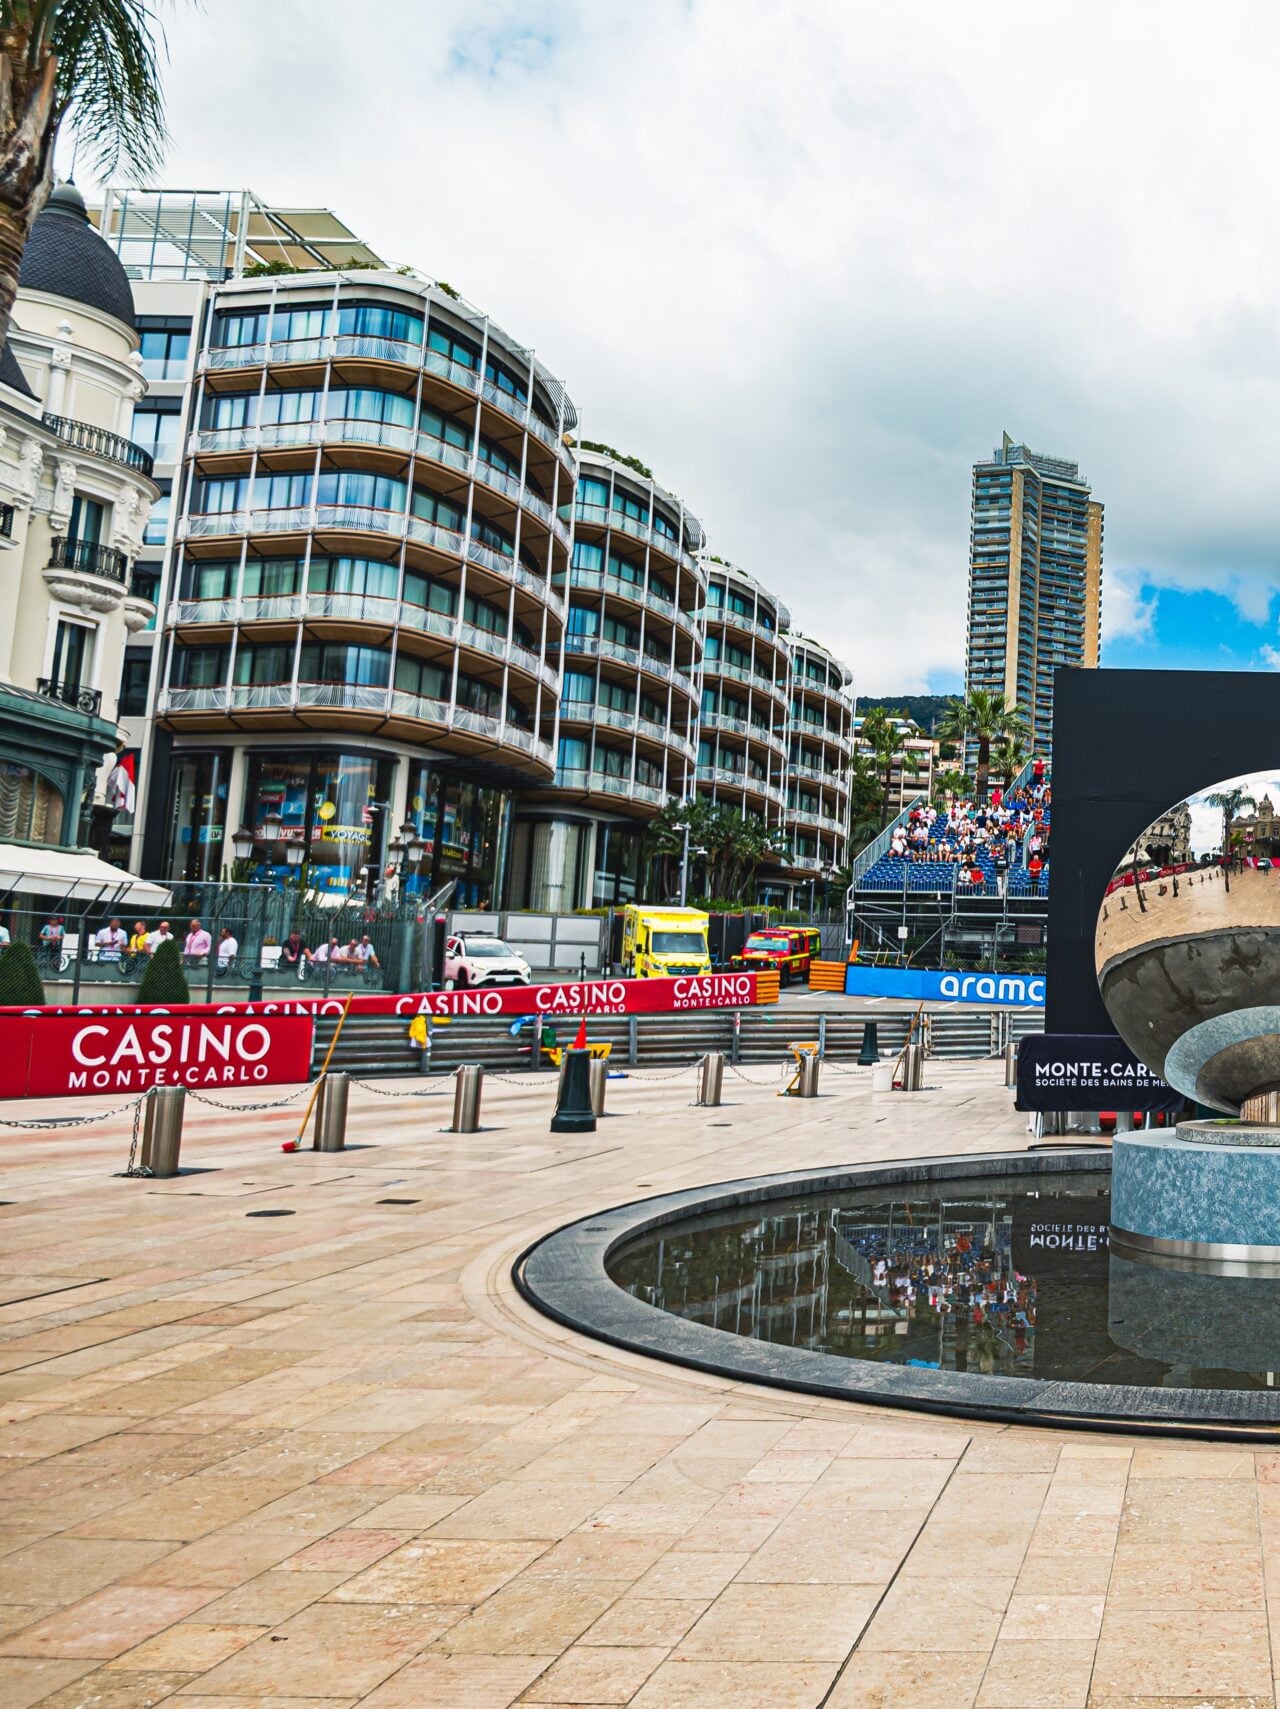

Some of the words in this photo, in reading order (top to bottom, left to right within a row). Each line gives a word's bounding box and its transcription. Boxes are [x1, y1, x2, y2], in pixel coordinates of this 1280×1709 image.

[535, 982, 626, 1010] CASINO
[674, 976, 751, 998] CASINO
[940, 975, 1045, 1002] aramc
[395, 992, 503, 1015] CASINO
[673, 997, 711, 1007] MONTE
[717, 995, 751, 1005] CARLO
[71, 1023, 272, 1067] CASINO
[67, 1067, 167, 1089] MONTE
[184, 1063, 269, 1084] CARLO
[1035, 1062, 1102, 1077] MONTE
[1035, 1077, 1077, 1087] SOCIÉTÉ
[1080, 1079, 1100, 1087] DES
[1103, 1078, 1133, 1087] BAINS
[1136, 1079, 1149, 1087] DE
[1152, 1079, 1169, 1087] ME
